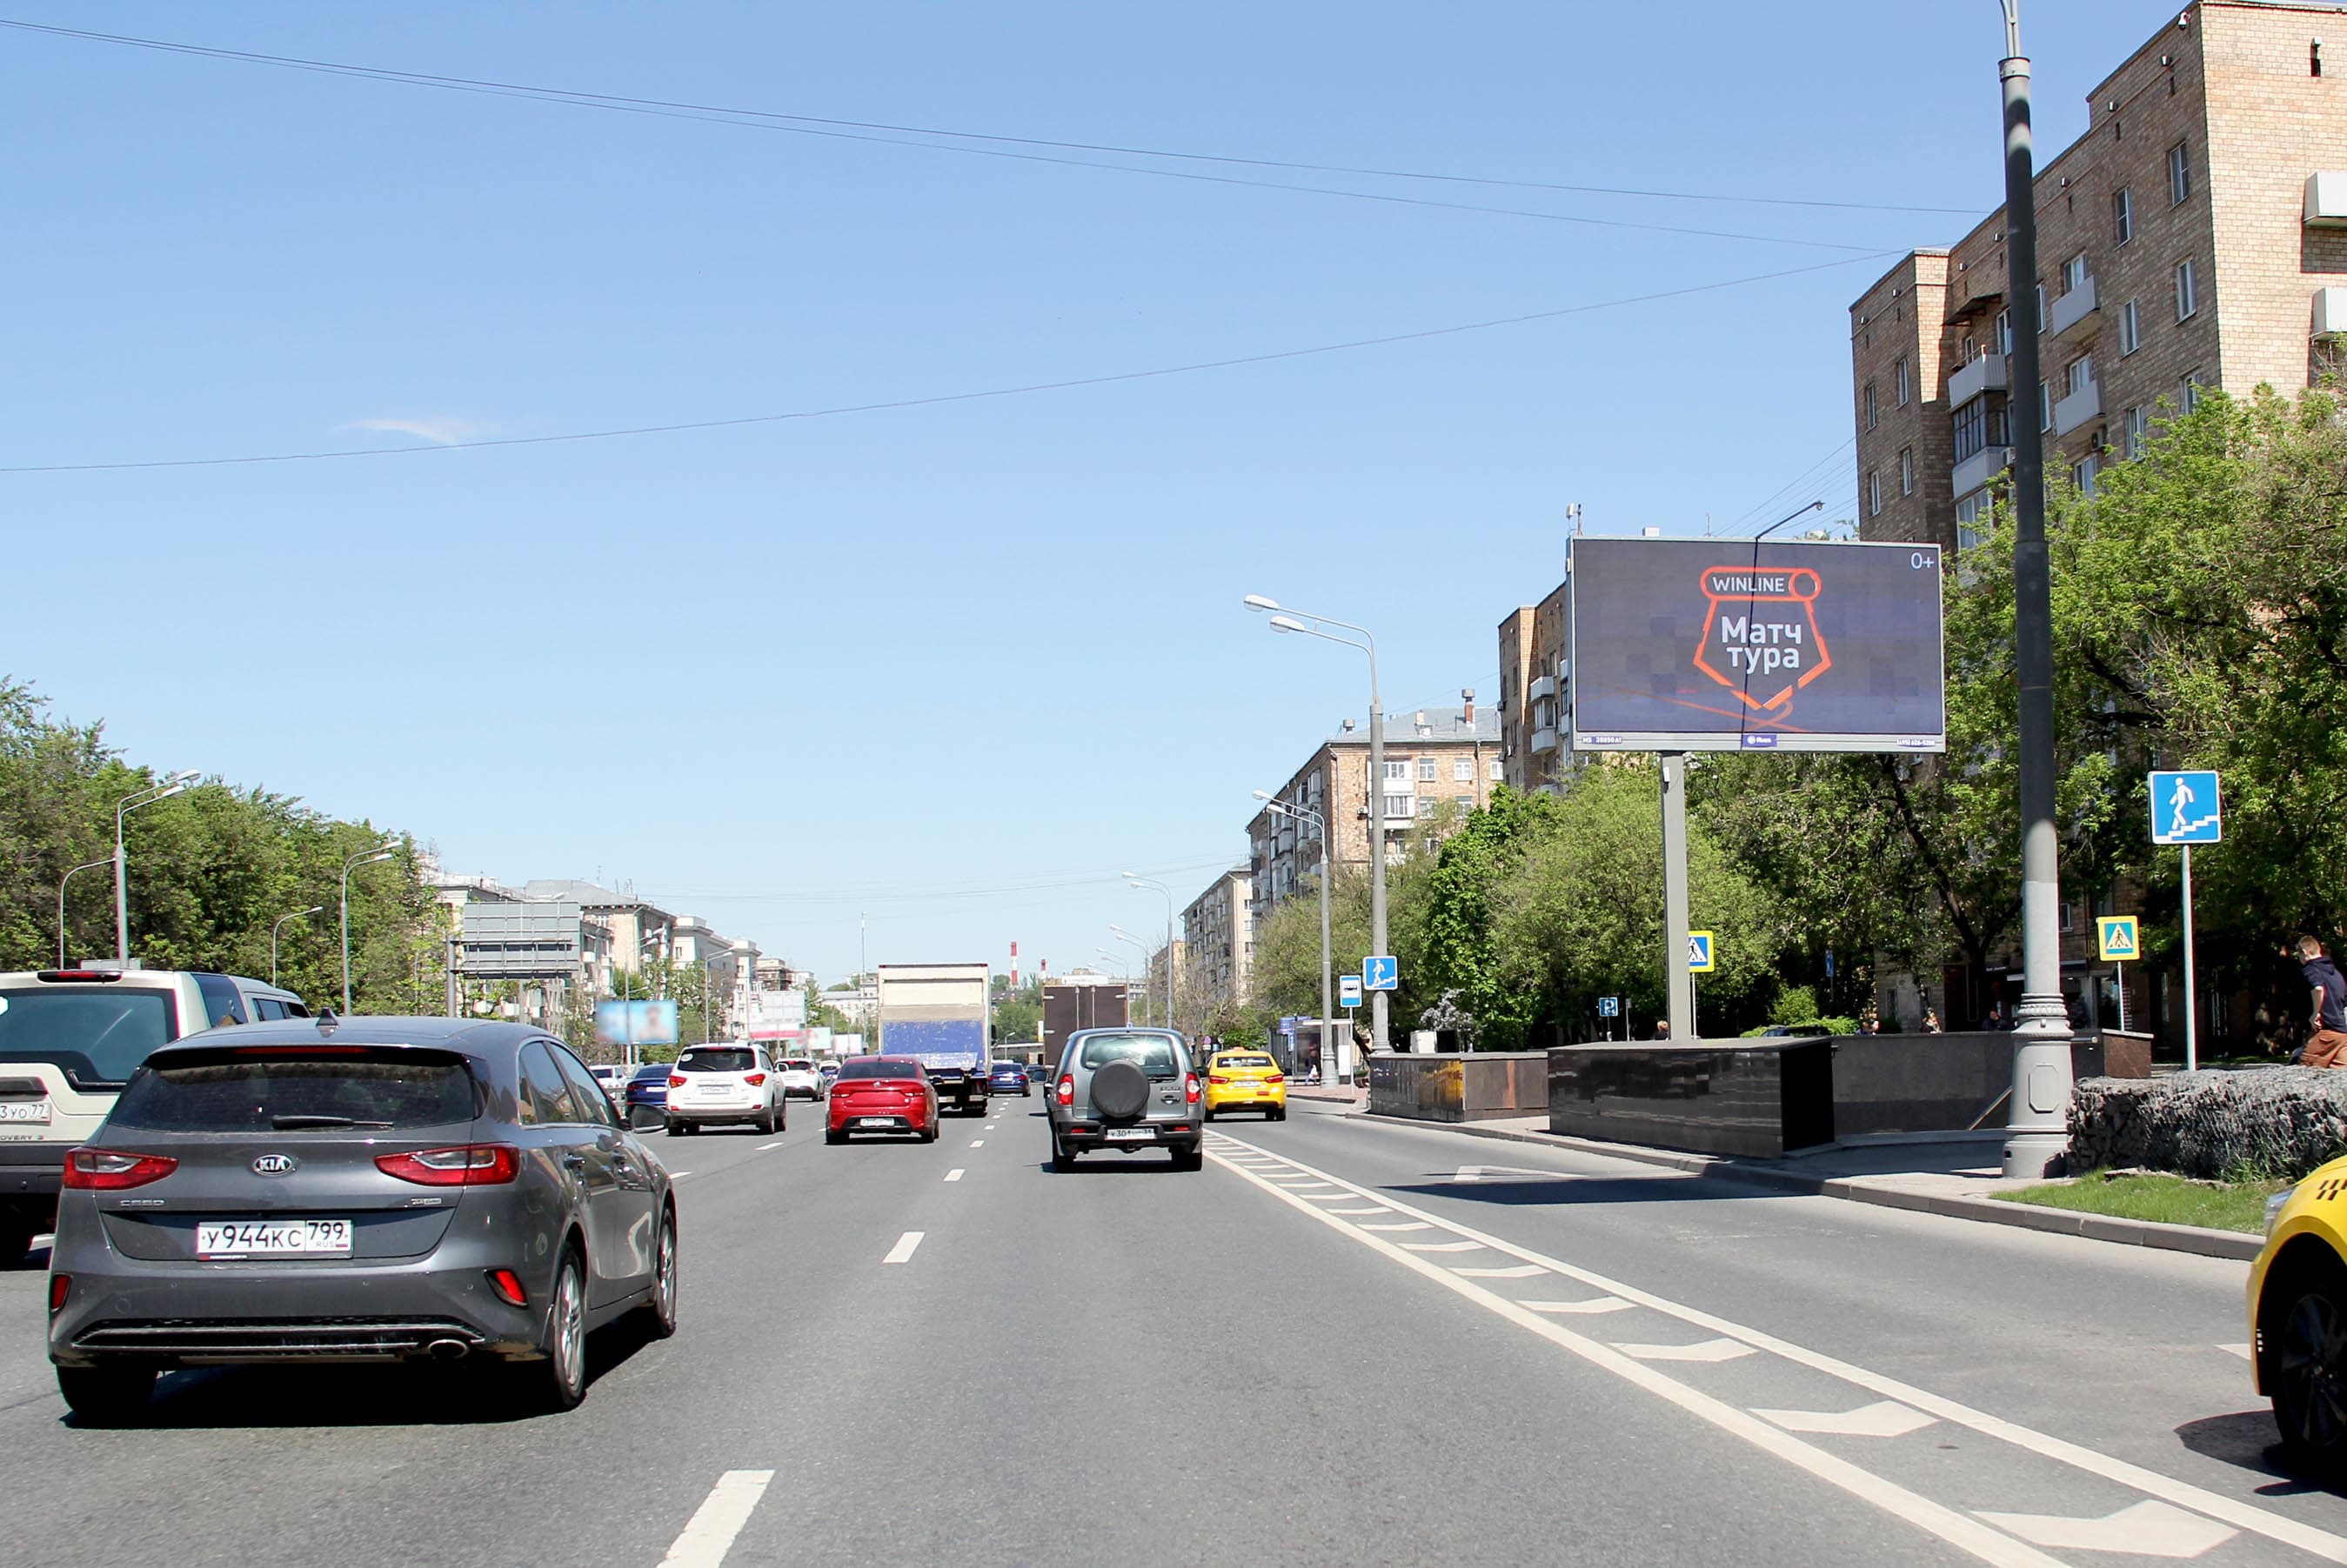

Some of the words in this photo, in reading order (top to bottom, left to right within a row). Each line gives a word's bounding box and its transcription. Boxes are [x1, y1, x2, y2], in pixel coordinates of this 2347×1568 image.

[1910, 552, 1935, 570] 0+
[1712, 577, 1785, 592] WINLINE
[1722, 616, 1802, 644] Матч
[1726, 646, 1800, 675] тура
[260, 1158, 286, 1171] KIA
[308, 1222, 344, 1240] 799
